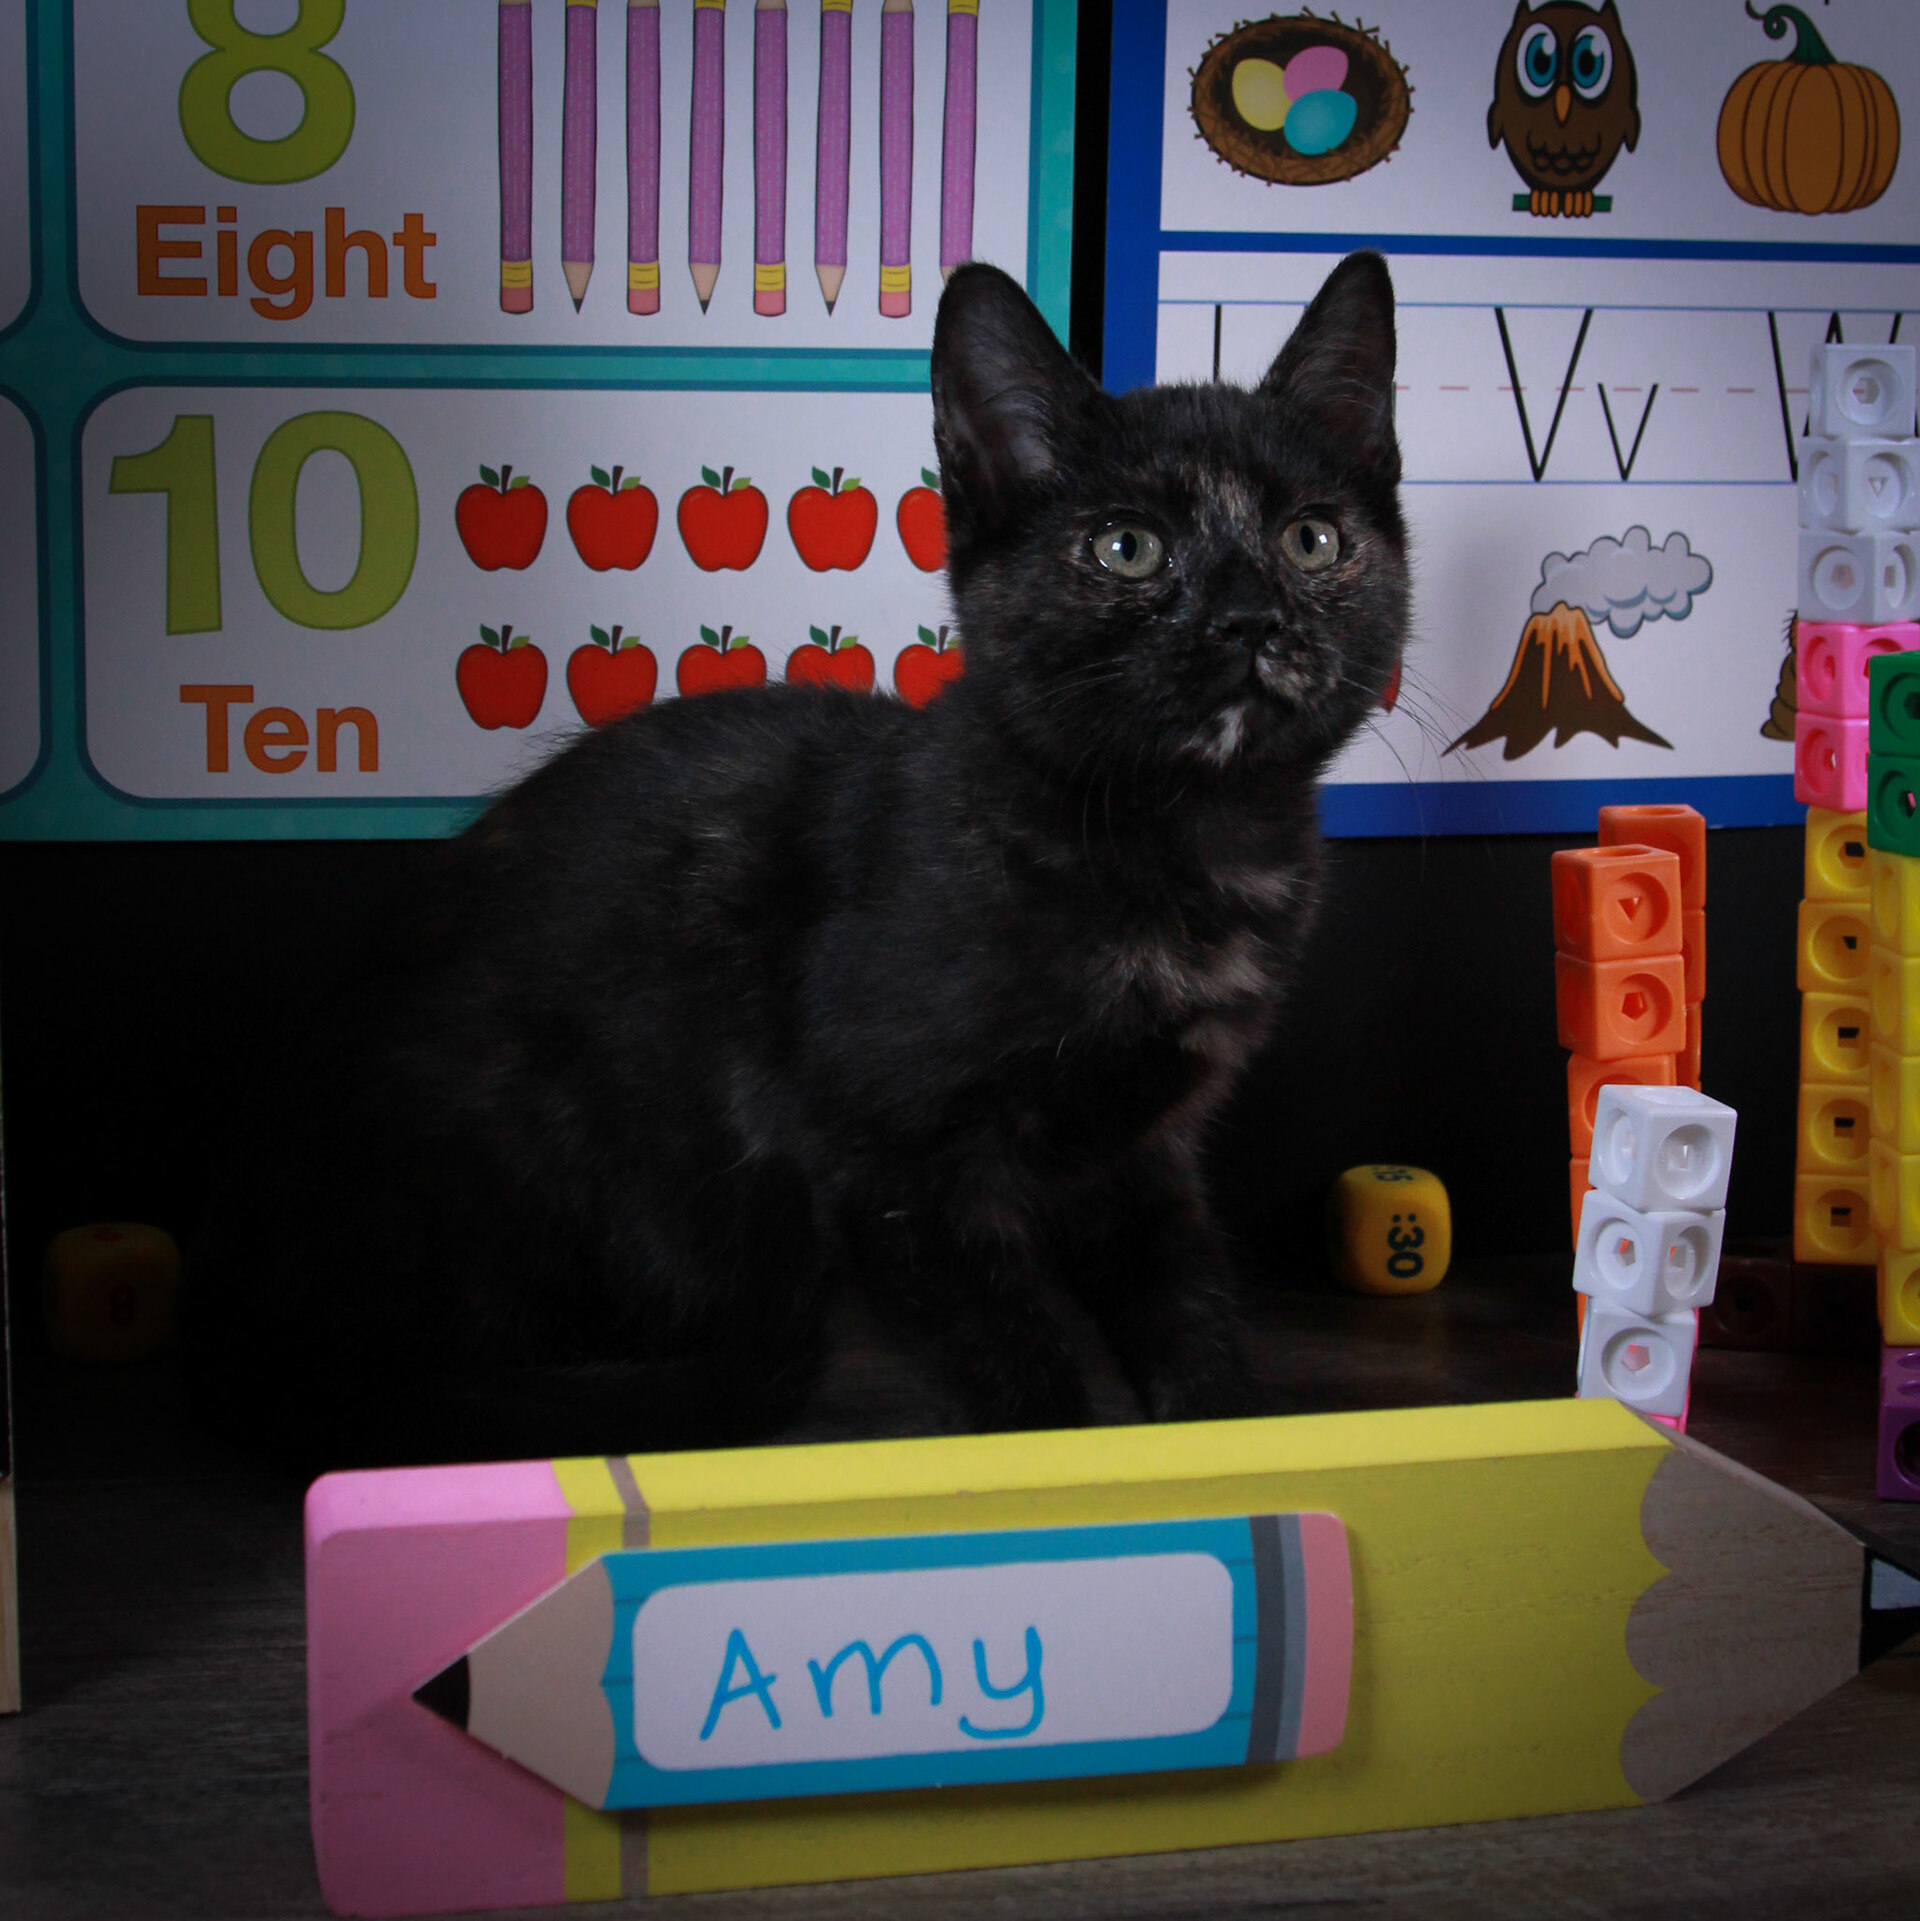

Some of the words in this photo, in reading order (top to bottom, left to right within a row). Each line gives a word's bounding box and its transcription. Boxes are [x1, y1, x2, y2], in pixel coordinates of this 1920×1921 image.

[178, 0, 356, 185] 8
[135, 204, 437, 321] Eight
[108, 410, 419, 636] 10
[180, 685, 380, 773] Ten
[1387, 1214, 1424, 1278] :30
[700, 1627, 1044, 1740] Amy
